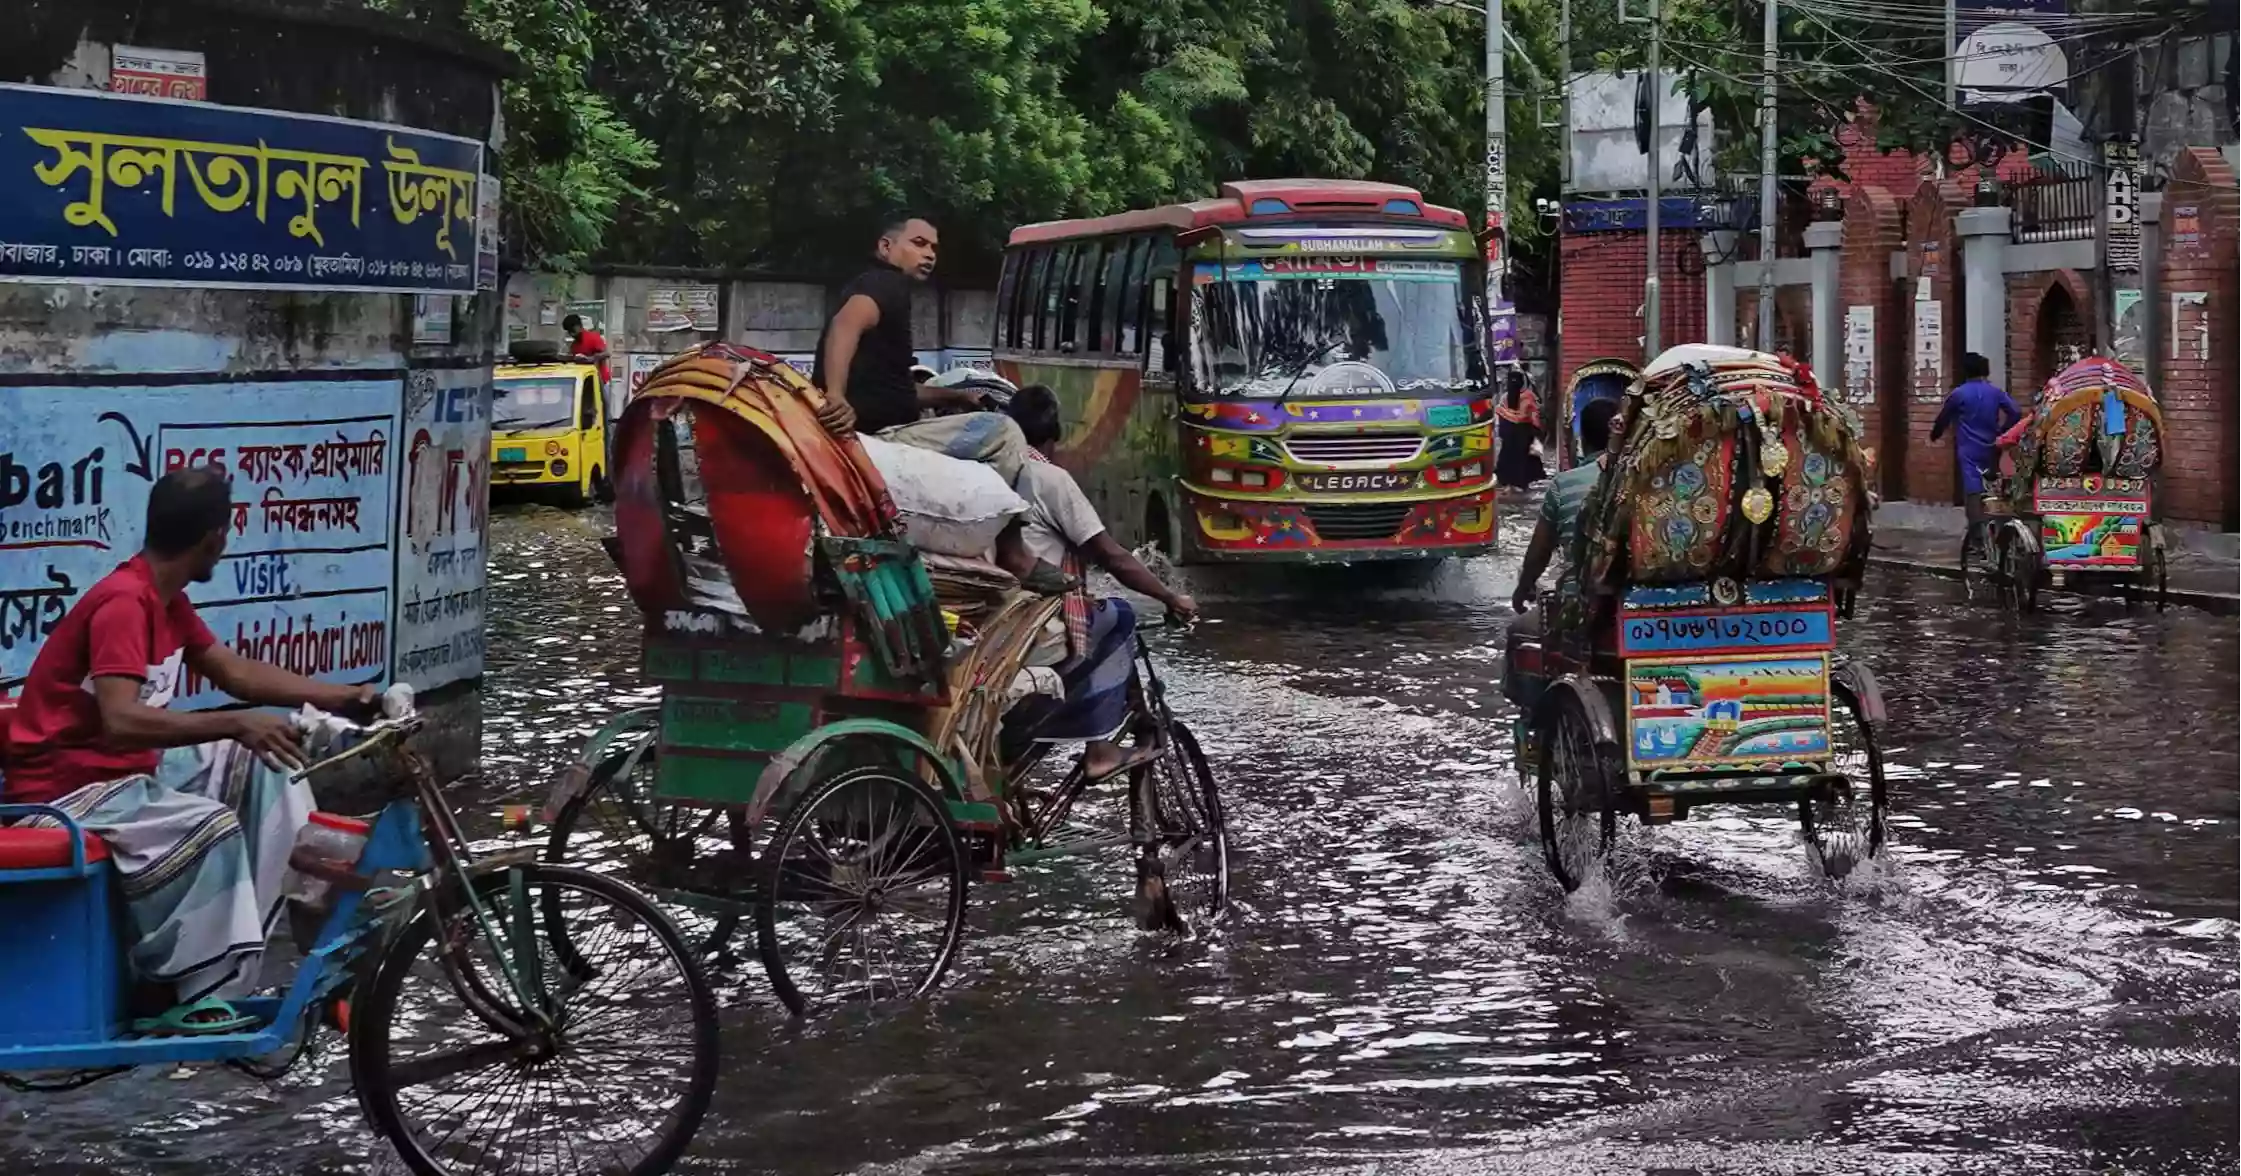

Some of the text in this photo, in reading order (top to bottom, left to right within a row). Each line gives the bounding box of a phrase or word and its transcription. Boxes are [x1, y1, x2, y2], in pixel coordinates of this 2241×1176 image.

[21, 127, 371, 247] সুলতানুল
[1313, 475, 1397, 490] LEGACY
[234, 552, 292, 596] Visit
